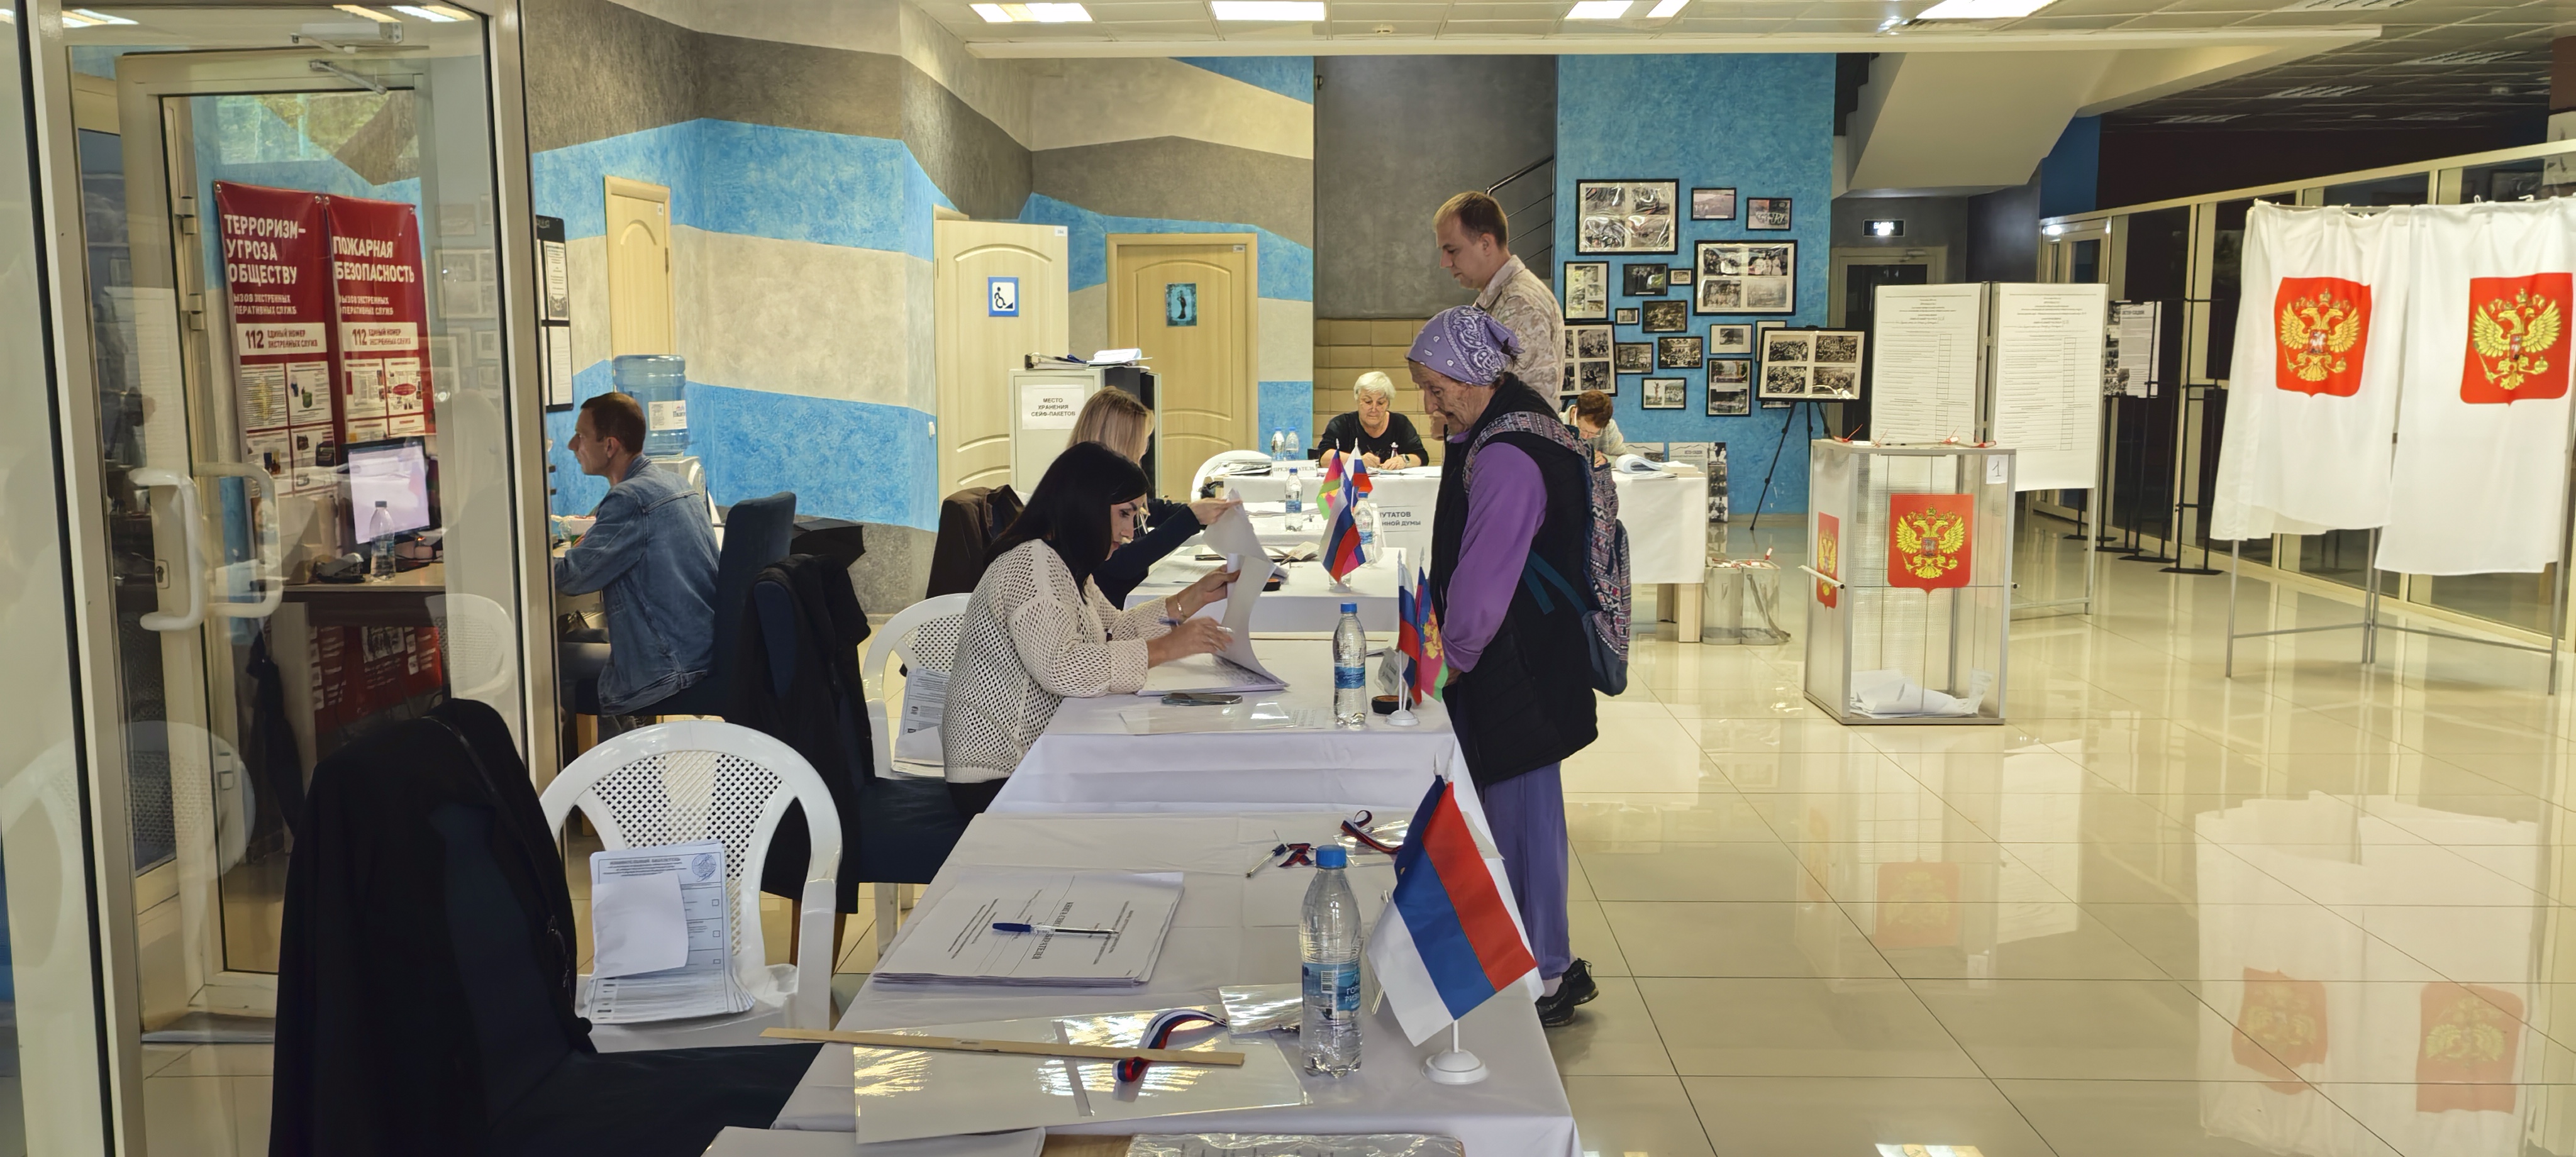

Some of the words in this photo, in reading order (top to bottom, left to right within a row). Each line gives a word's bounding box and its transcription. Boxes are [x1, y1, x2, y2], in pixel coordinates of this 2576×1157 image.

[226, 238, 278, 261] УГРОЗА
[333, 236, 394, 258] ПОЖАРНАЯ
[228, 263, 297, 287] ОБЩЕСТВУ
[334, 261, 415, 283] БЕЗОПАСНОСТЬ
[233, 293, 253, 302] ЫЗОВ
[340, 295, 357, 304] ЫЗОВ
[233, 305, 276, 315] ПЕРАТИВНЫХ
[340, 306, 374, 315] ПЕРАТИВНЫХ
[245, 329, 264, 349] 112
[352, 328, 367, 346] 112
[1992, 460, 2002, 477] 1
